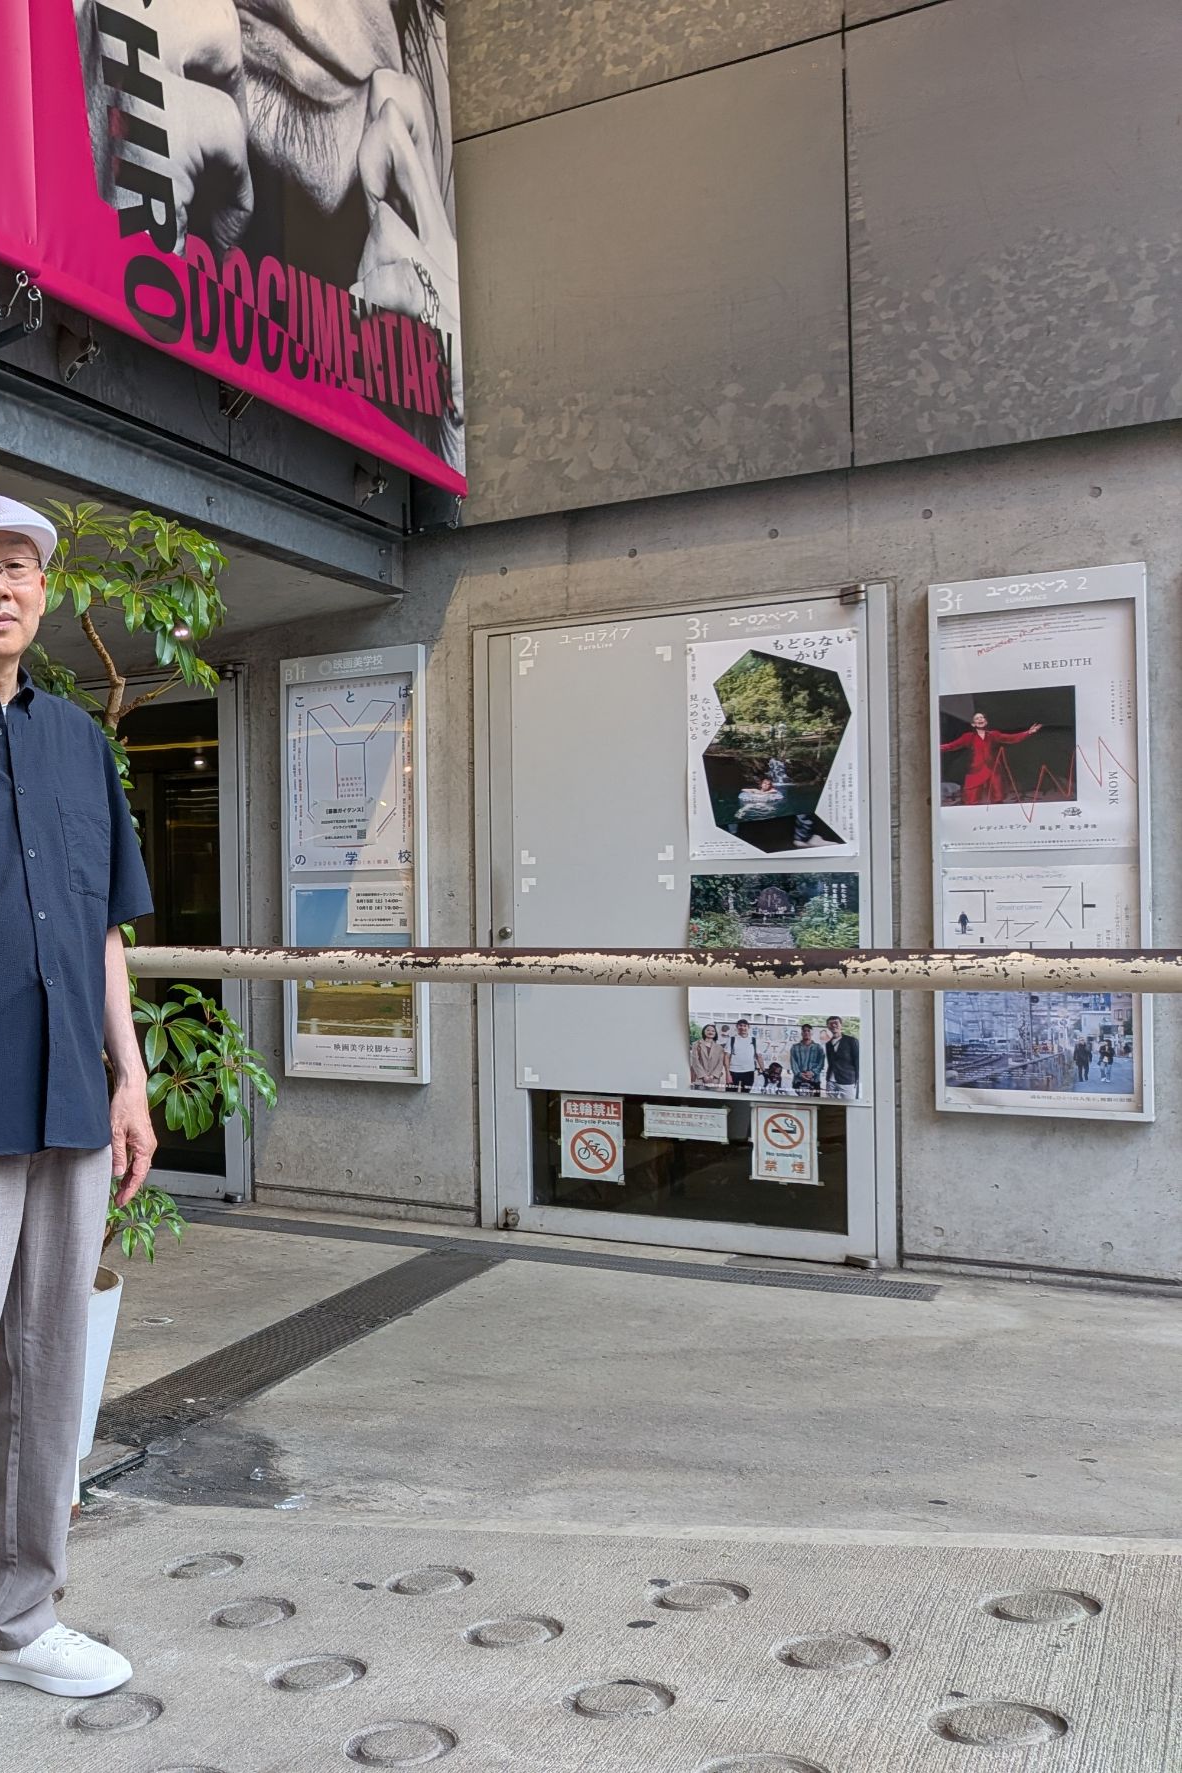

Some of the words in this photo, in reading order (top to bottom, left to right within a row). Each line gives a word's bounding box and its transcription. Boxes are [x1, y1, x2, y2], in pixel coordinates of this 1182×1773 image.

[94, 0, 186, 344] HIRO
[185, 233, 454, 417] DOCUMENTARY
[1076, 577, 1088, 590] 2
[936, 587, 963, 612] 3f
[729, 610, 799, 626] ユーロスペース
[804, 609, 813, 620] 1
[685, 617, 709, 640] 3f
[519, 636, 540, 657] 2f
[773, 635, 852, 650] もどらない
[333, 654, 383, 669] 映画美学校
[794, 648, 829, 661] かげ
[284, 663, 306, 681] B1f
[1023, 658, 1092, 670] MEREDITH
[690, 694, 699, 740] 見つめている
[1108, 771, 1119, 805] MONK
[566, 1102, 619, 1116] 駐輪禁止
[597, 1119, 620, 1127] Parking
